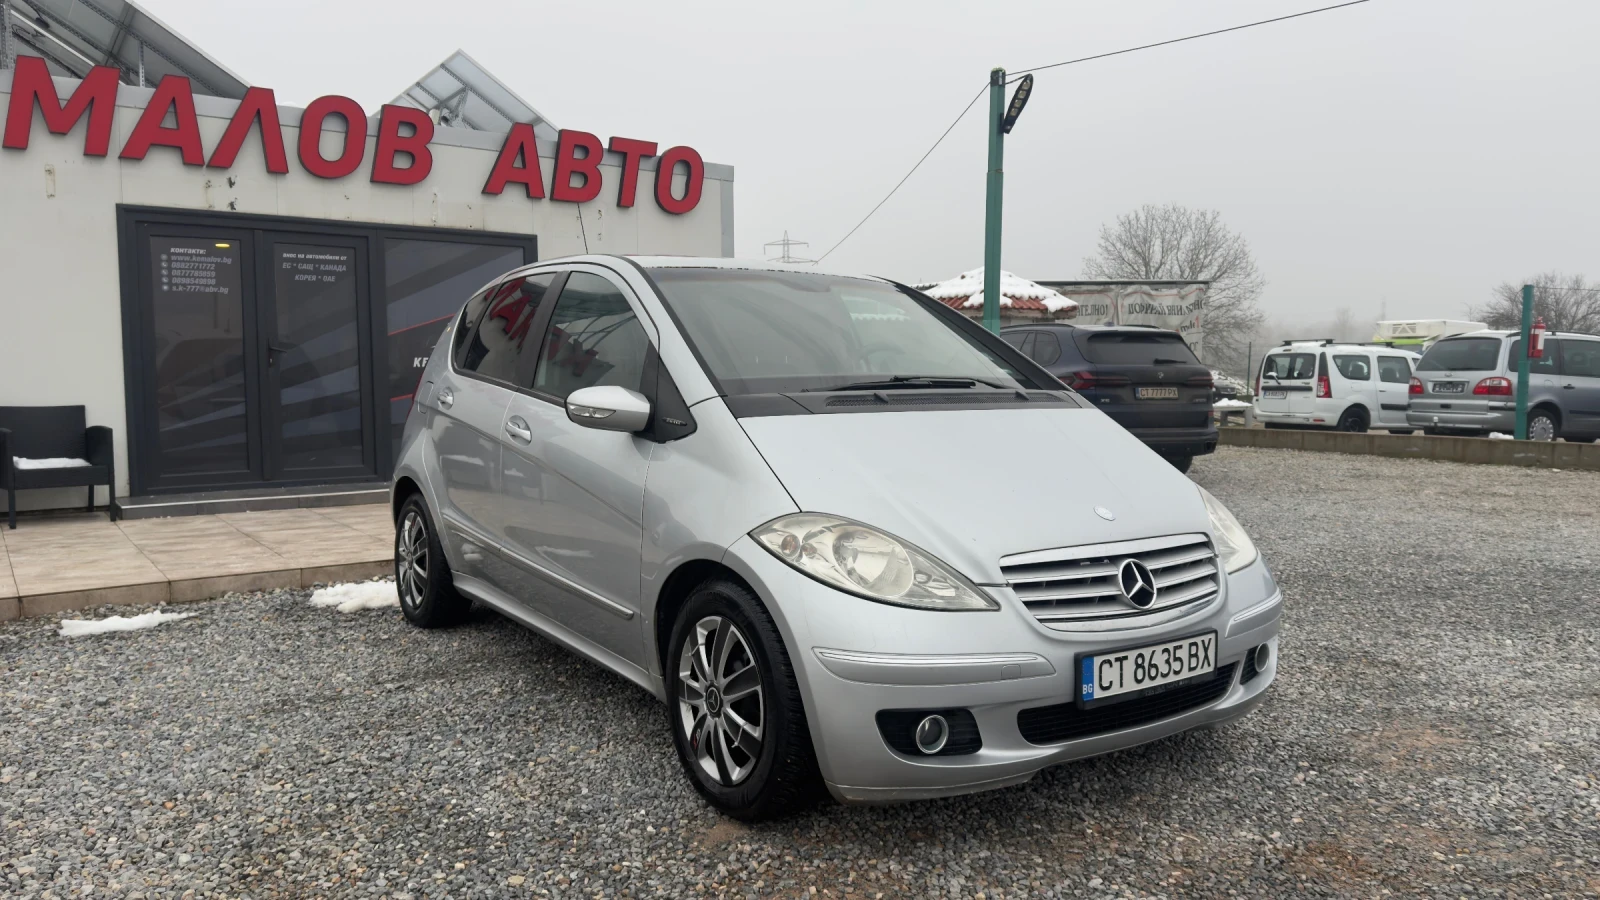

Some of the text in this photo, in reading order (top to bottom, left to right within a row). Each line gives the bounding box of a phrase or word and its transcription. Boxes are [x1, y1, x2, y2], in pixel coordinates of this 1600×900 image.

[2, 54, 704, 215] МАЛОВ АВТО
[298, 263, 314, 271] САЩ
[320, 264, 347, 272] КАНАДА
[1151, 388, 1167, 397] 7777
[1098, 655, 1129, 691] CT
[1133, 644, 1184, 685] 8635
[1187, 637, 1213, 672] BX
[1082, 683, 1093, 695] BG
